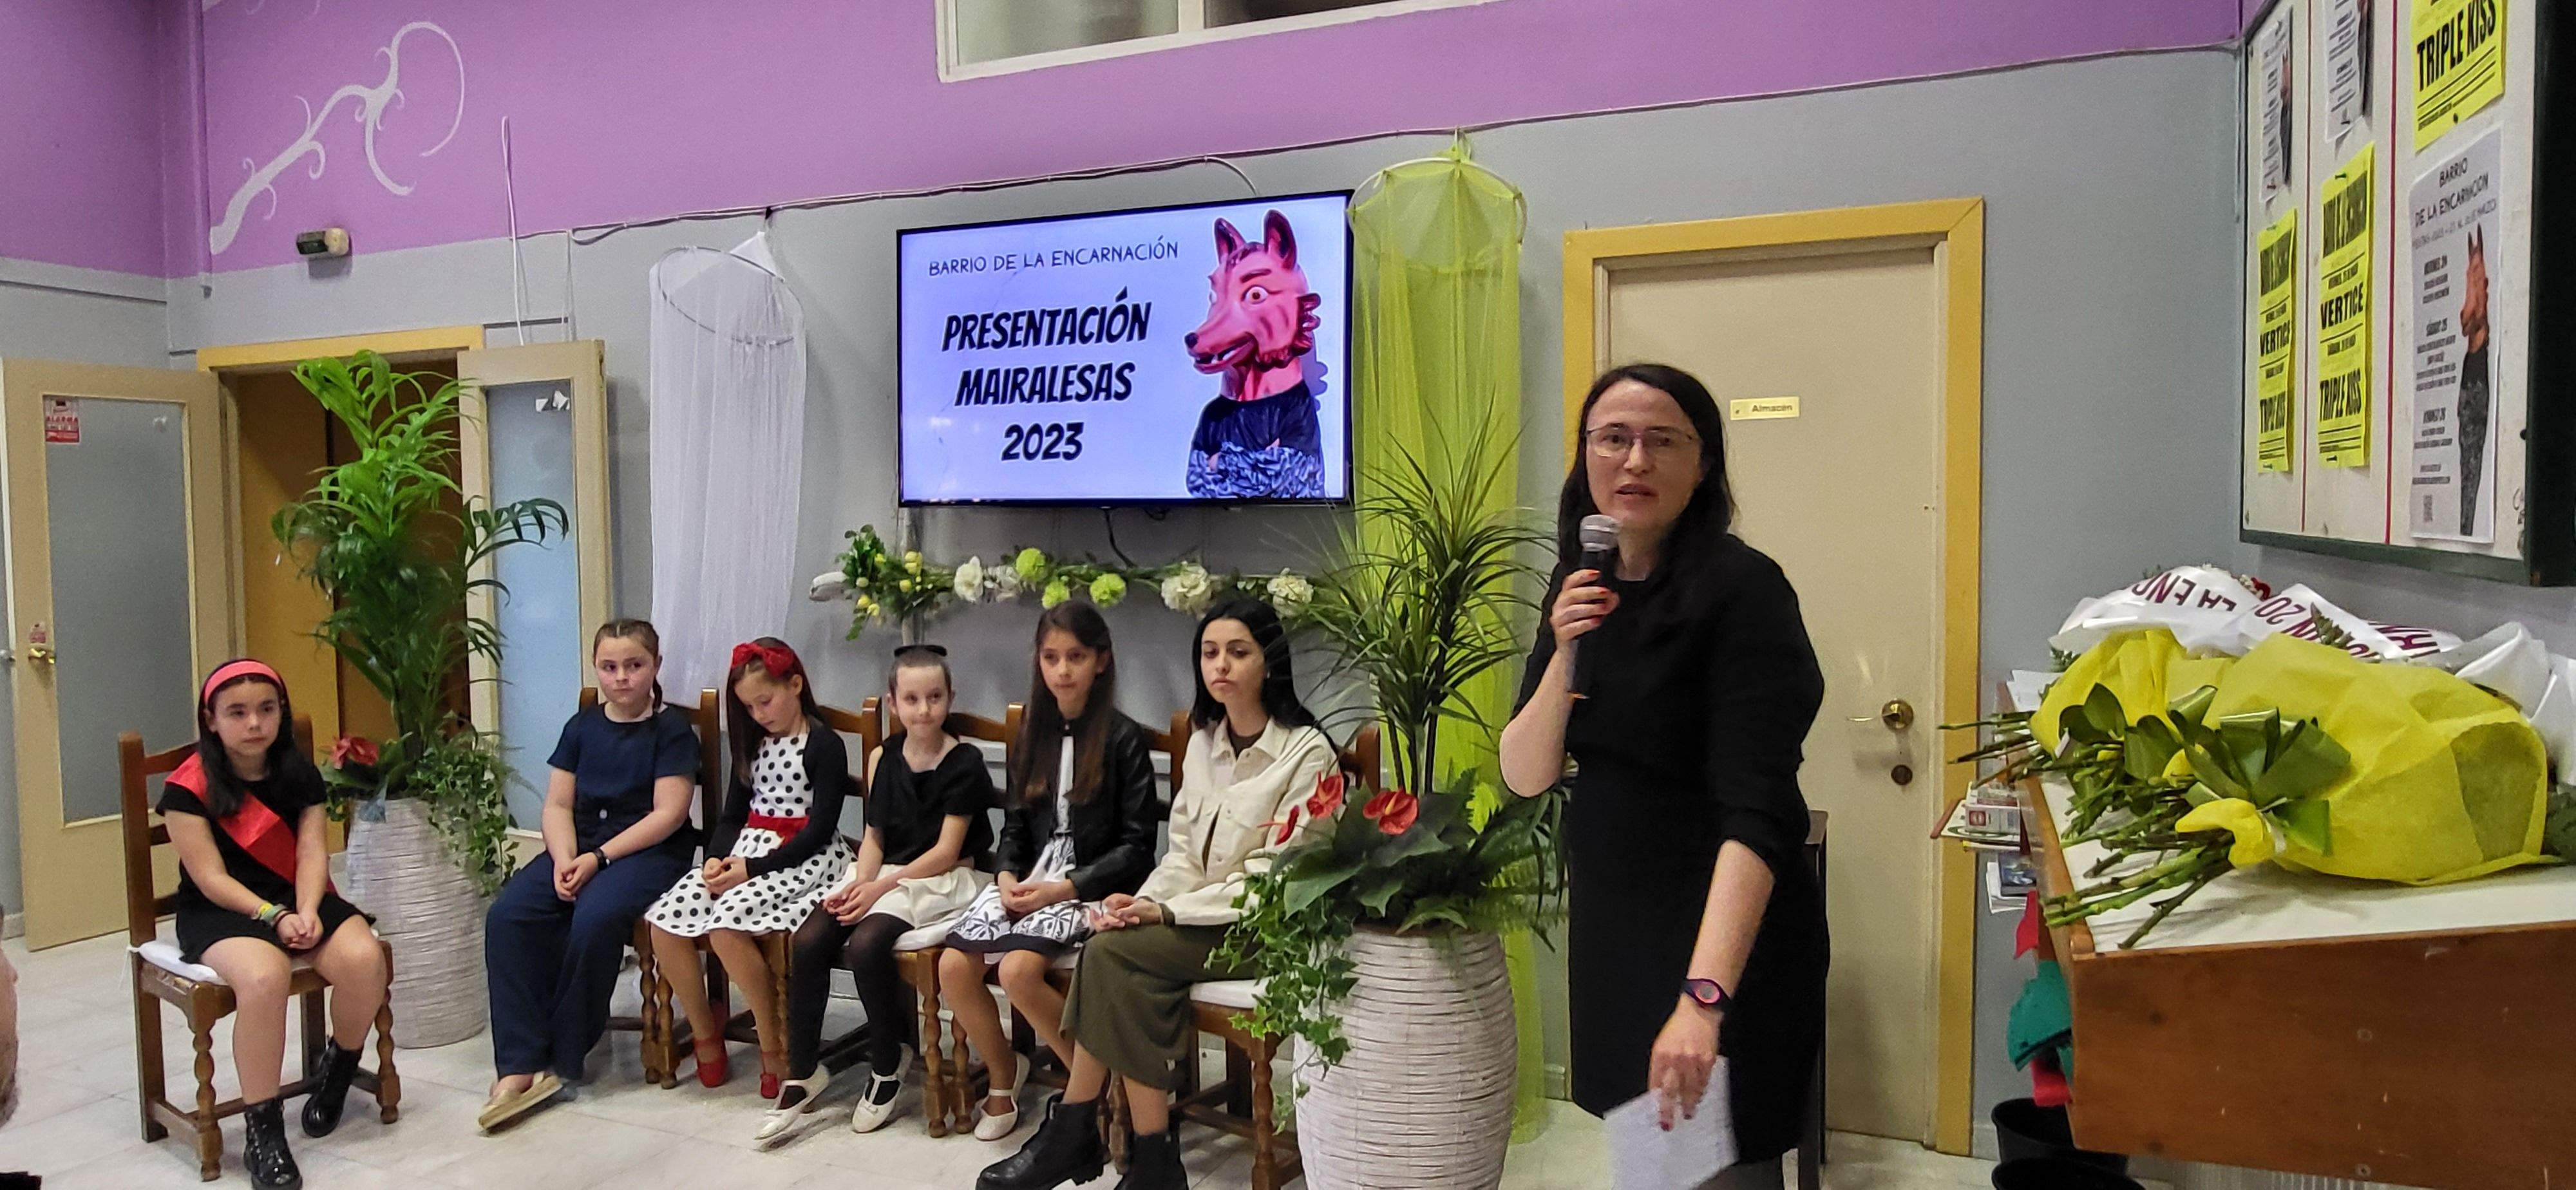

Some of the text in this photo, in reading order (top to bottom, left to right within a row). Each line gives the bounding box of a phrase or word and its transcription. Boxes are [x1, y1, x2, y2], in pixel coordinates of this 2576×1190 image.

[2417, 9, 2463, 92] TRIPLE
[2467, 0, 2496, 57] KISS
[2439, 157, 2468, 188] BARRIO
[2414, 208, 2425, 228] DE
[2427, 203, 2438, 222] LA
[929, 235, 1179, 276] BARRIO DE LA ENCARNACIÓN
[942, 285, 1152, 352] PRESENTACIÓN
[2320, 281, 2364, 330] VERTICE
[954, 361, 1136, 407] MAIRALESAS
[2320, 374, 2345, 422] TRIPLE
[1001, 421, 1084, 462] 2023
